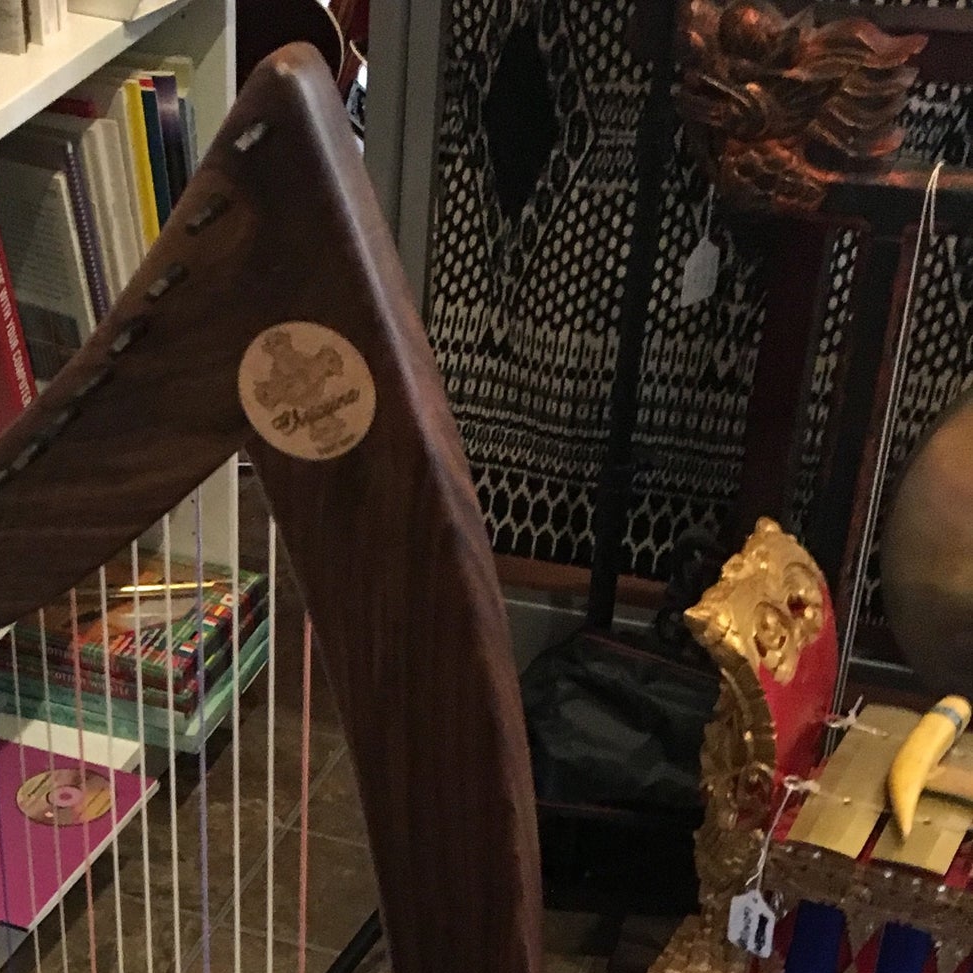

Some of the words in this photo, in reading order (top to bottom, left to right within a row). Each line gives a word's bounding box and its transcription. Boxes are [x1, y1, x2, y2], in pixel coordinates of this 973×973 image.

[0, 287, 13, 321] WITH
[6, 320, 19, 351] YOUR
[12, 349, 32, 408] COMPUTER
